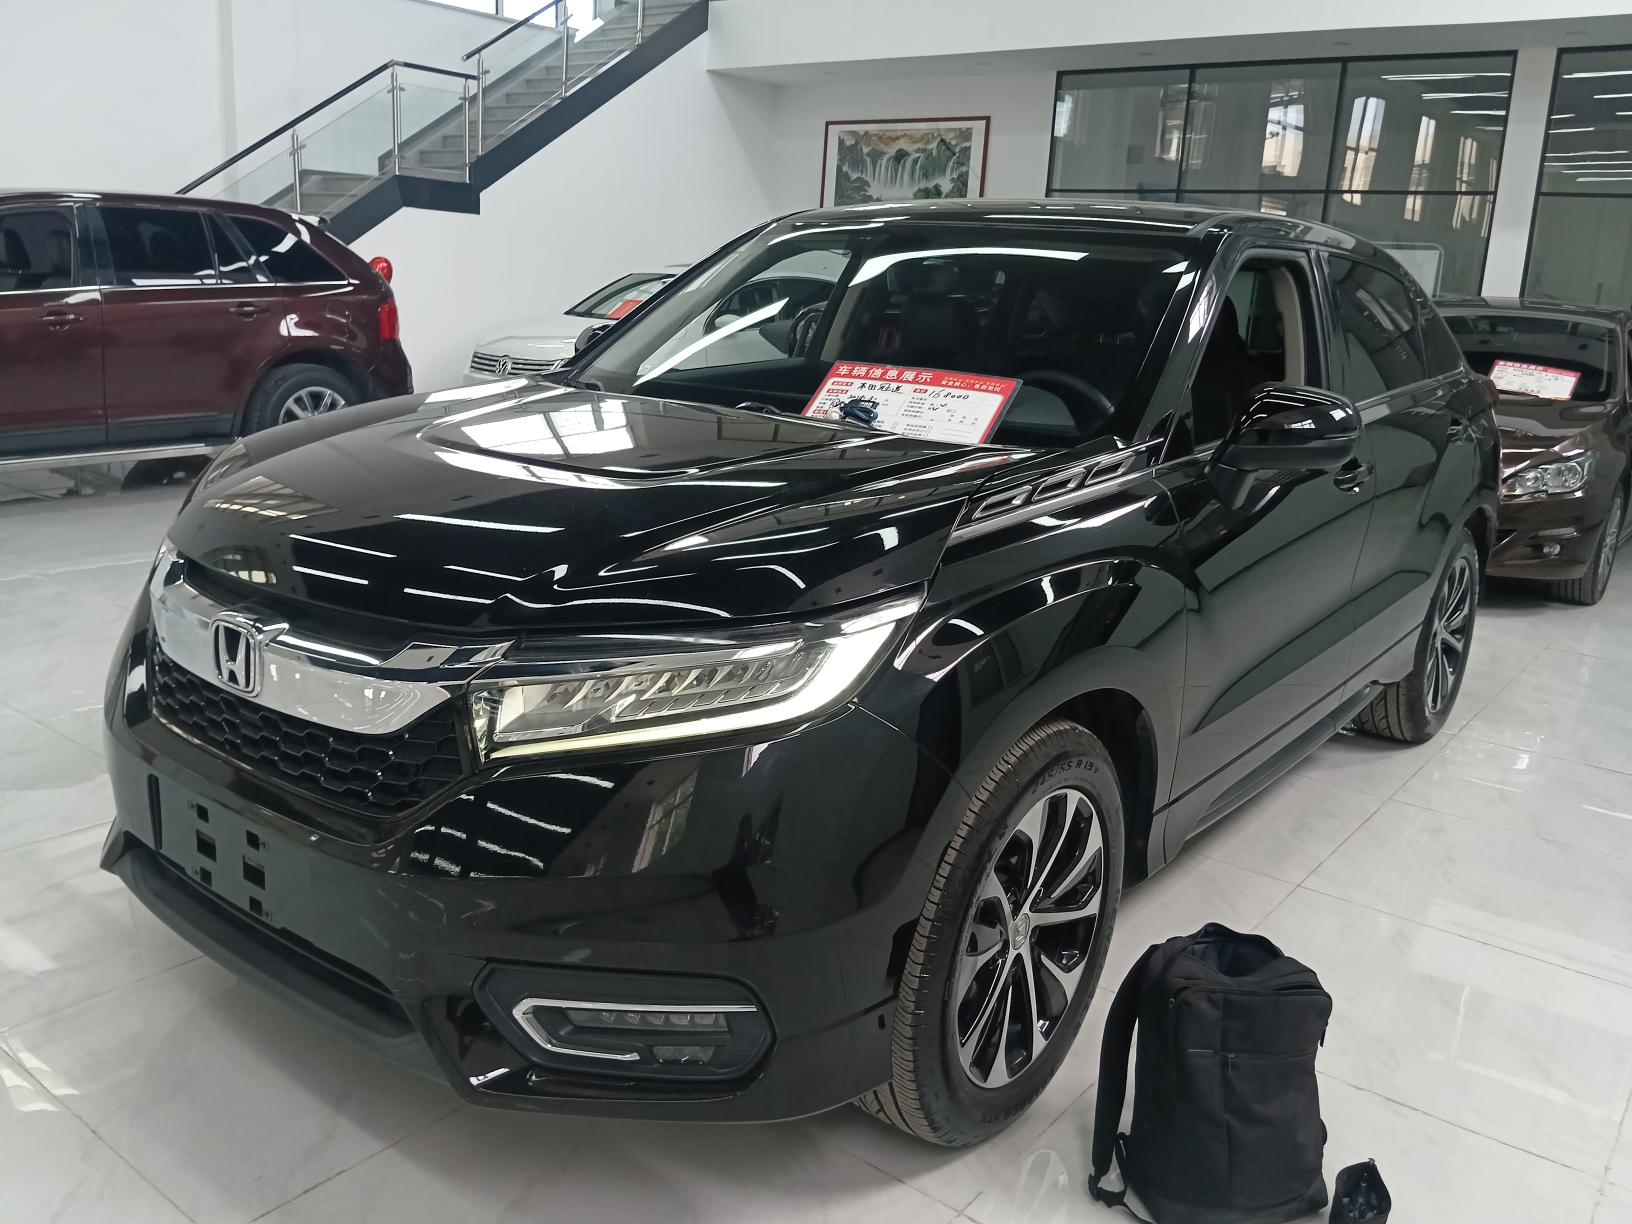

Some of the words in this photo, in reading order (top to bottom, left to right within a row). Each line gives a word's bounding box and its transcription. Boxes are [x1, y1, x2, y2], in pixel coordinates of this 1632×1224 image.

[836, 364, 933, 382] 车辆信息展示
[929, 388, 970, 400] 168000
